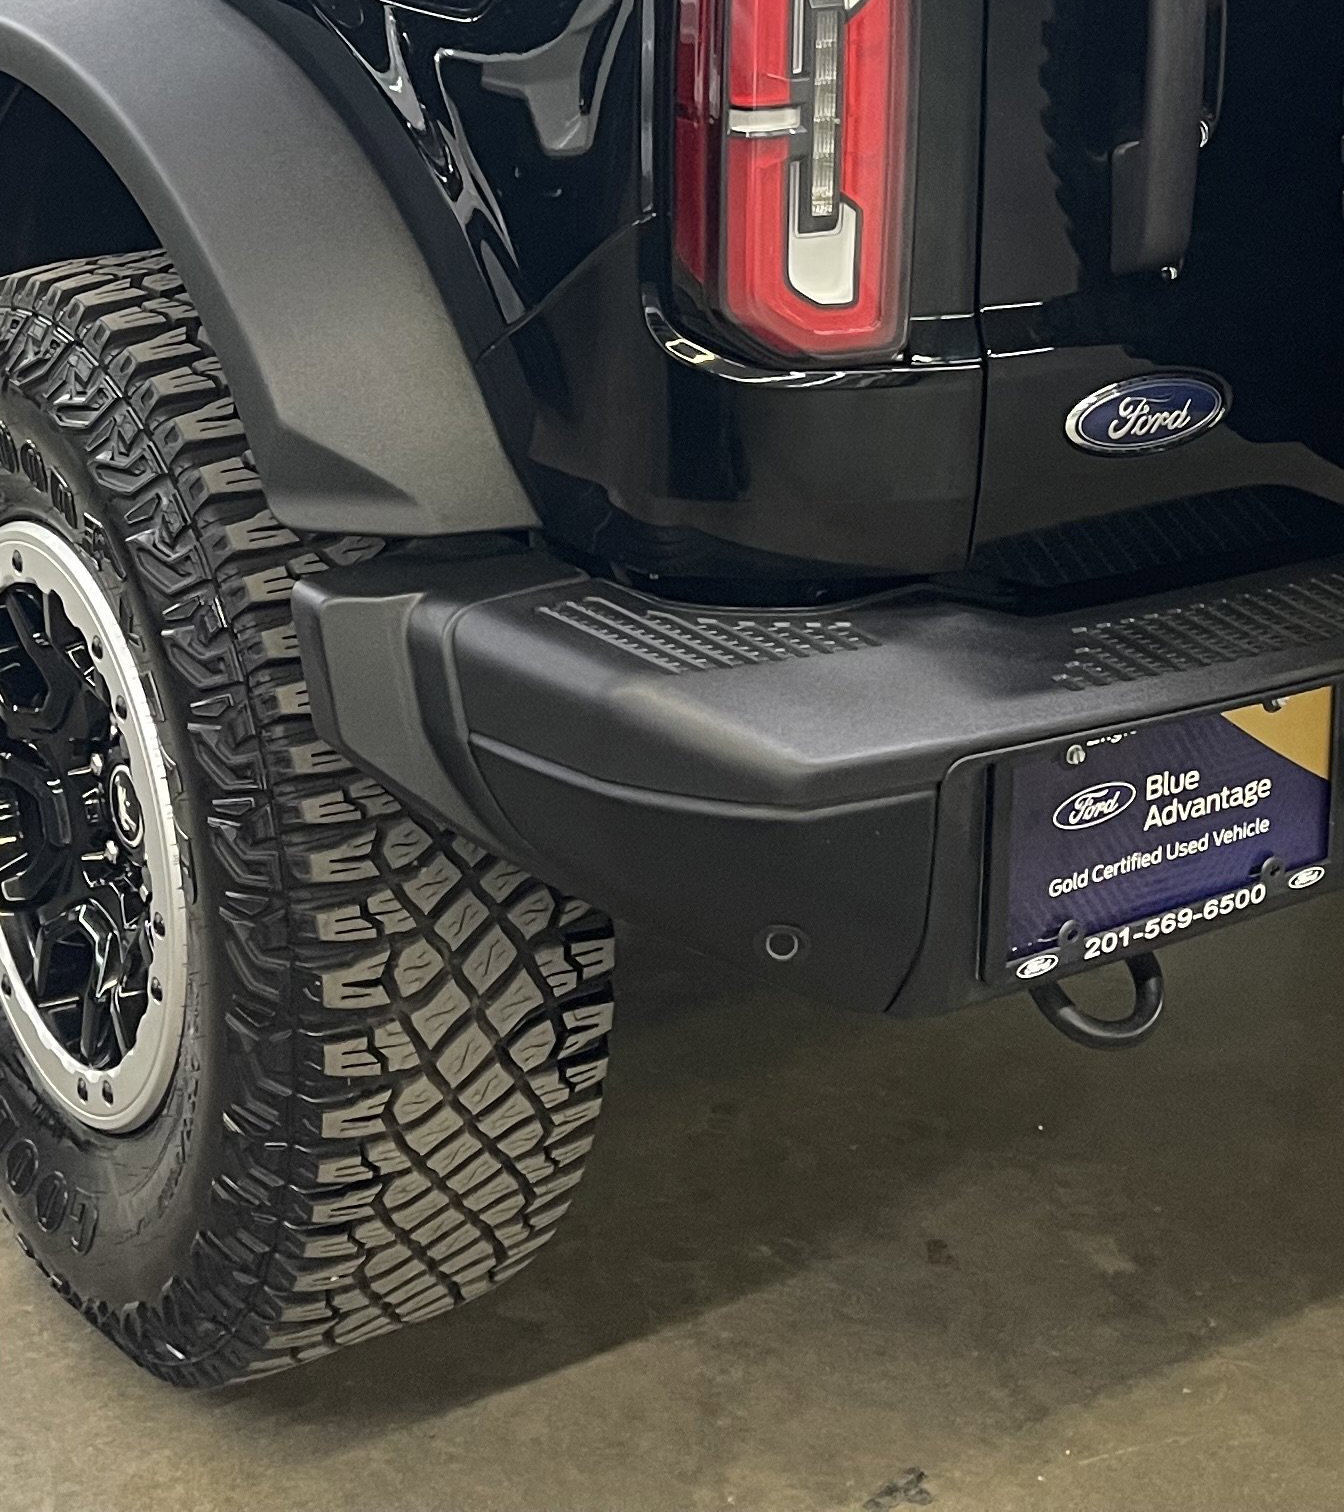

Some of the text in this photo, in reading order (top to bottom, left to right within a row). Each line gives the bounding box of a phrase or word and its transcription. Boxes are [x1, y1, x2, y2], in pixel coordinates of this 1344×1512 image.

[1108, 392, 1192, 440] Ford
[1068, 789, 1121, 825] Ford
[1143, 778, 1272, 831] Advantage
[1145, 769, 1201, 801] Blue
[1048, 818, 1271, 898] Gold Certified Used Vehicle
[1084, 883, 1267, 961] 201-569-6500
